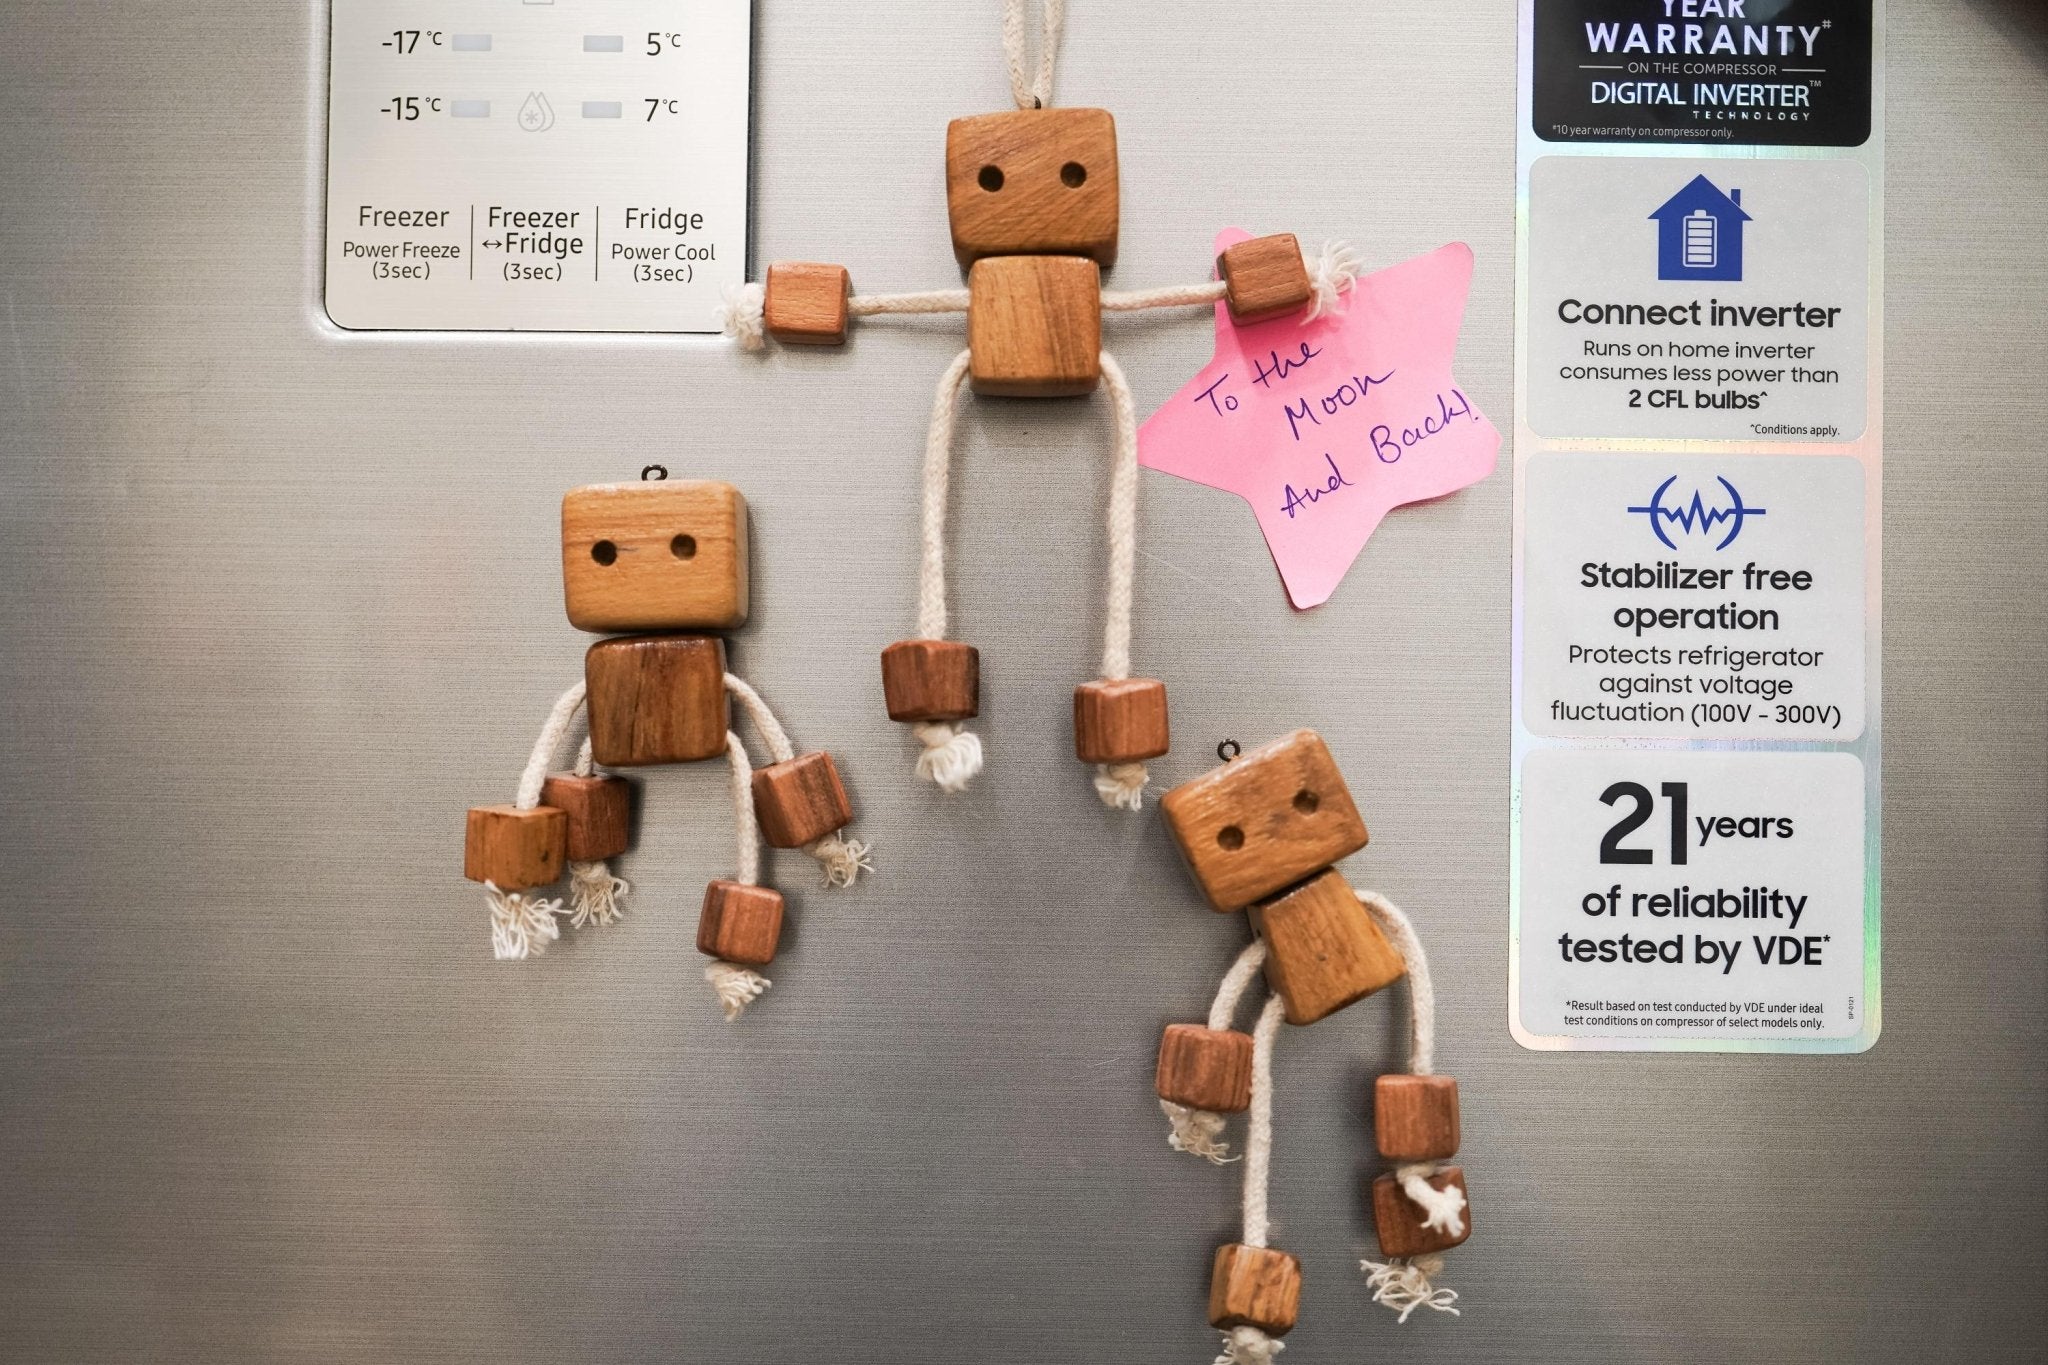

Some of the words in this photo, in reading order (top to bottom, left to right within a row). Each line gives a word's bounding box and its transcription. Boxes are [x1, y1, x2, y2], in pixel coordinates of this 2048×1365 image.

[1662, 0, 1746, 18] YEAR
[1628, 62, 1649, 74] ON
[1653, 62, 1679, 74] THE
[1683, 63, 1777, 76] COMPRESSOR
[1591, 82, 1687, 105] DIGITAL
[1693, 110, 1810, 121] TECHNOLOGY
[1570, 127, 1592, 137] year
[1592, 127, 1637, 138] warranty
[1639, 128, 1650, 136] on
[1653, 127, 1709, 138] compressor
[1712, 127, 1734, 138] only.
[359, 205, 450, 227] Freezer
[488, 206, 579, 228] Freezer
[625, 208, 704, 235] Fridge
[343, 242, 399, 258] Power
[402, 242, 460, 259] Freeze
[506, 232, 584, 259] Fridge
[612, 244, 671, 260] Power
[675, 244, 716, 261] Cool
[372, 262, 430, 280] (3sec)
[503, 263, 562, 281] (3sec)
[633, 265, 693, 282] (3sec)
[1558, 299, 1701, 326] Connect
[1711, 299, 1841, 328] inverter
[1583, 341, 1631, 357] Runs
[1637, 342, 1663, 357] on
[1669, 341, 1730, 358] home
[1735, 341, 1815, 359] inverter
[1194, 373, 1238, 417] To
[1252, 342, 1322, 388] the
[1559, 364, 1667, 381] consumes
[1673, 365, 1711, 381] less
[1718, 368, 1785, 386] power
[1791, 366, 1839, 383] than
[1284, 369, 1395, 441] Moon
[1629, 389, 1641, 408] 2
[1648, 390, 1688, 409] CFL
[1810, 425, 1840, 437] apply.
[1281, 453, 1354, 518] And
[1581, 561, 1733, 589] Stabilizer
[1742, 562, 1813, 590] free
[1613, 602, 1779, 637] operation
[1569, 645, 1671, 665] Protects
[1678, 646, 1823, 672] refrigerator
[1599, 674, 1692, 698] against
[1700, 676, 1793, 700] voltage
[1551, 701, 1684, 722] fluctuation
[1691, 703, 1752, 728] (100V
[1775, 705, 1841, 729] 300V)
[1598, 781, 1688, 865] 21
[1696, 816, 1794, 846] years
[1582, 884, 1621, 917] of
[1632, 886, 1808, 929] reliability
[1558, 932, 1683, 964] tested
[1695, 935, 1742, 975] by
[1606, 1001, 1636, 1011] based
[1638, 1003, 1650, 1011] on
[1653, 1002, 1672, 1011] test
[1674, 1002, 1726, 1012] conducted
[1729, 1002, 1741, 1014] by
[1744, 1002, 1765, 1012] VDE
[1768, 1003, 1796, 1013] under
[1800, 1004, 1824, 1014] ideal
[1564, 1016, 1584, 1025] test
[1586, 1016, 1638, 1026] conditions
[1640, 1018, 1653, 1026] on
[1656, 1018, 1714, 1028] compressor
[1716, 1017, 1727, 1027] of
[1729, 1017, 1758, 1027] select
[1761, 1018, 1798, 1028] models
[1800, 1018, 1824, 1030] only.
